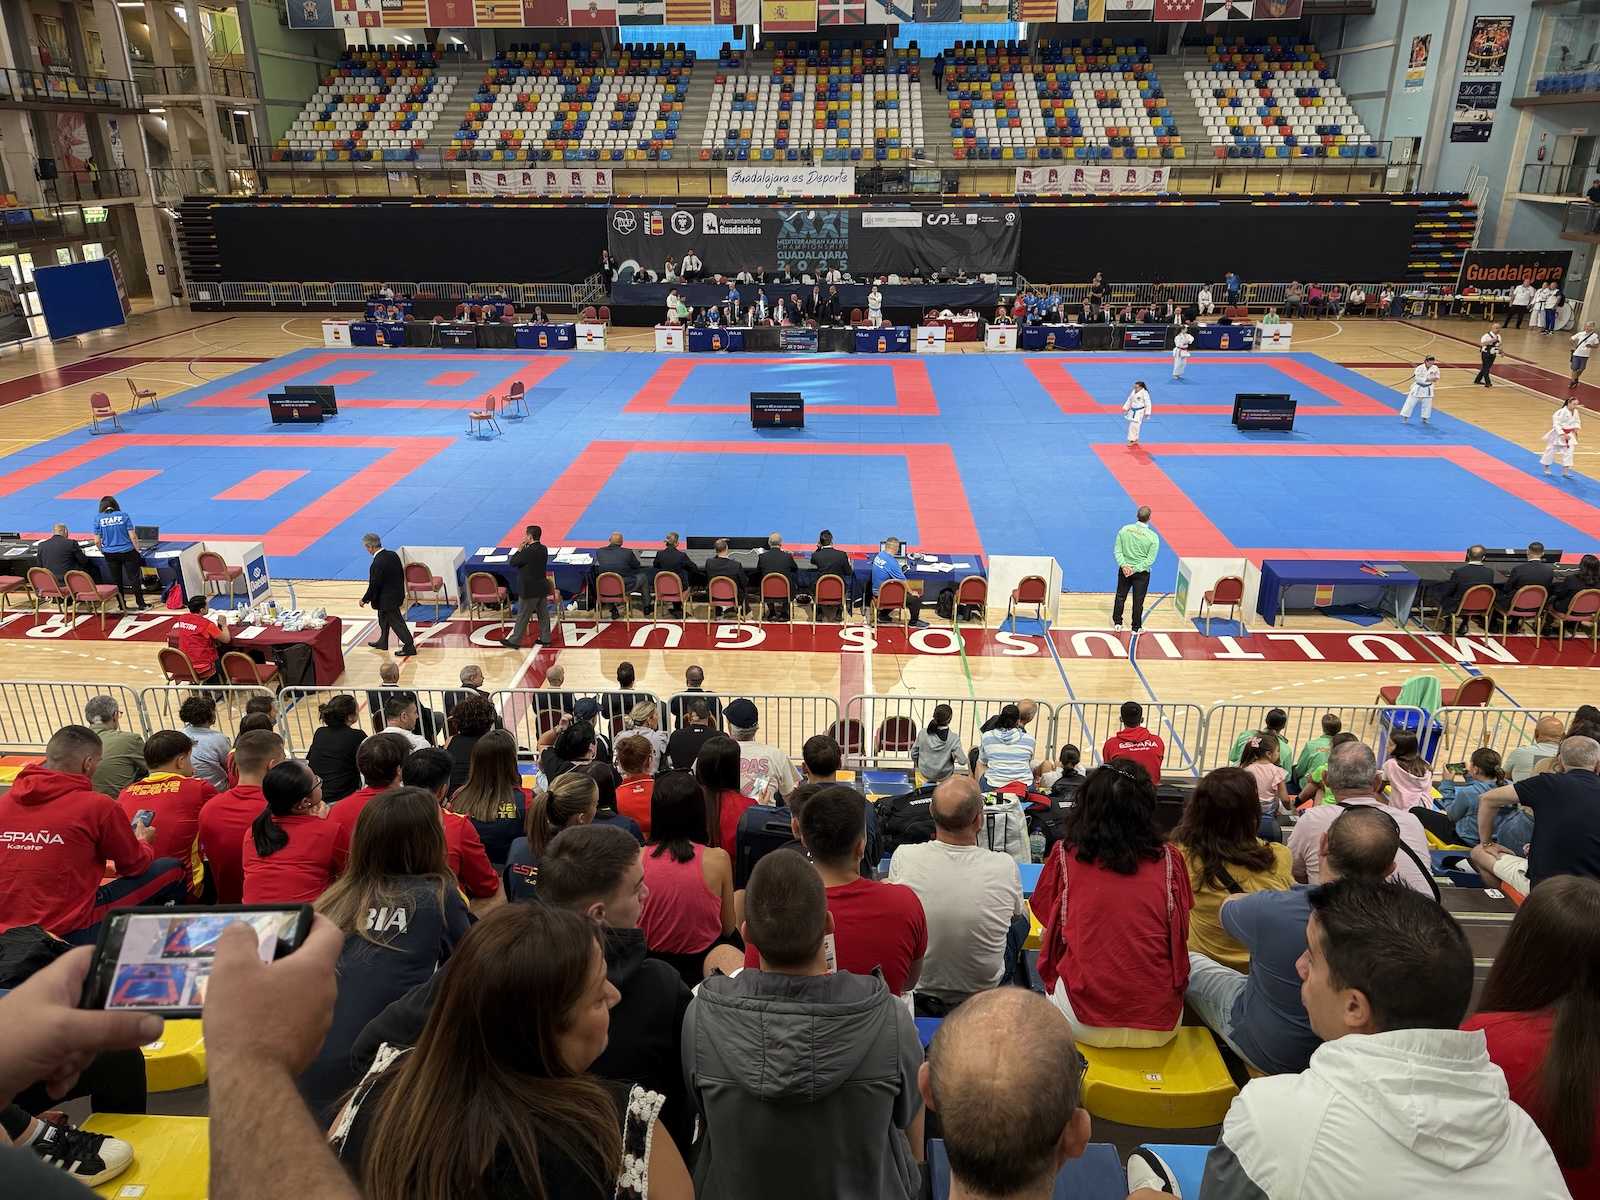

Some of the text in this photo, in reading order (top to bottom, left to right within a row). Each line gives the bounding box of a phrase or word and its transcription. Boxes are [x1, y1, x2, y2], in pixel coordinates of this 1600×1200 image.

[731, 169, 848, 189] Guadalajara es Deporte
[720, 217, 761, 226] Ayuntamiento de
[720, 225, 761, 235] Guadalajara
[776, 250, 848, 260] GUADALAJARA
[1467, 263, 1563, 283] Guadalajara
[100, 516, 123, 526] STAFF
[838, 627, 1520, 663] MULTIUSOS
